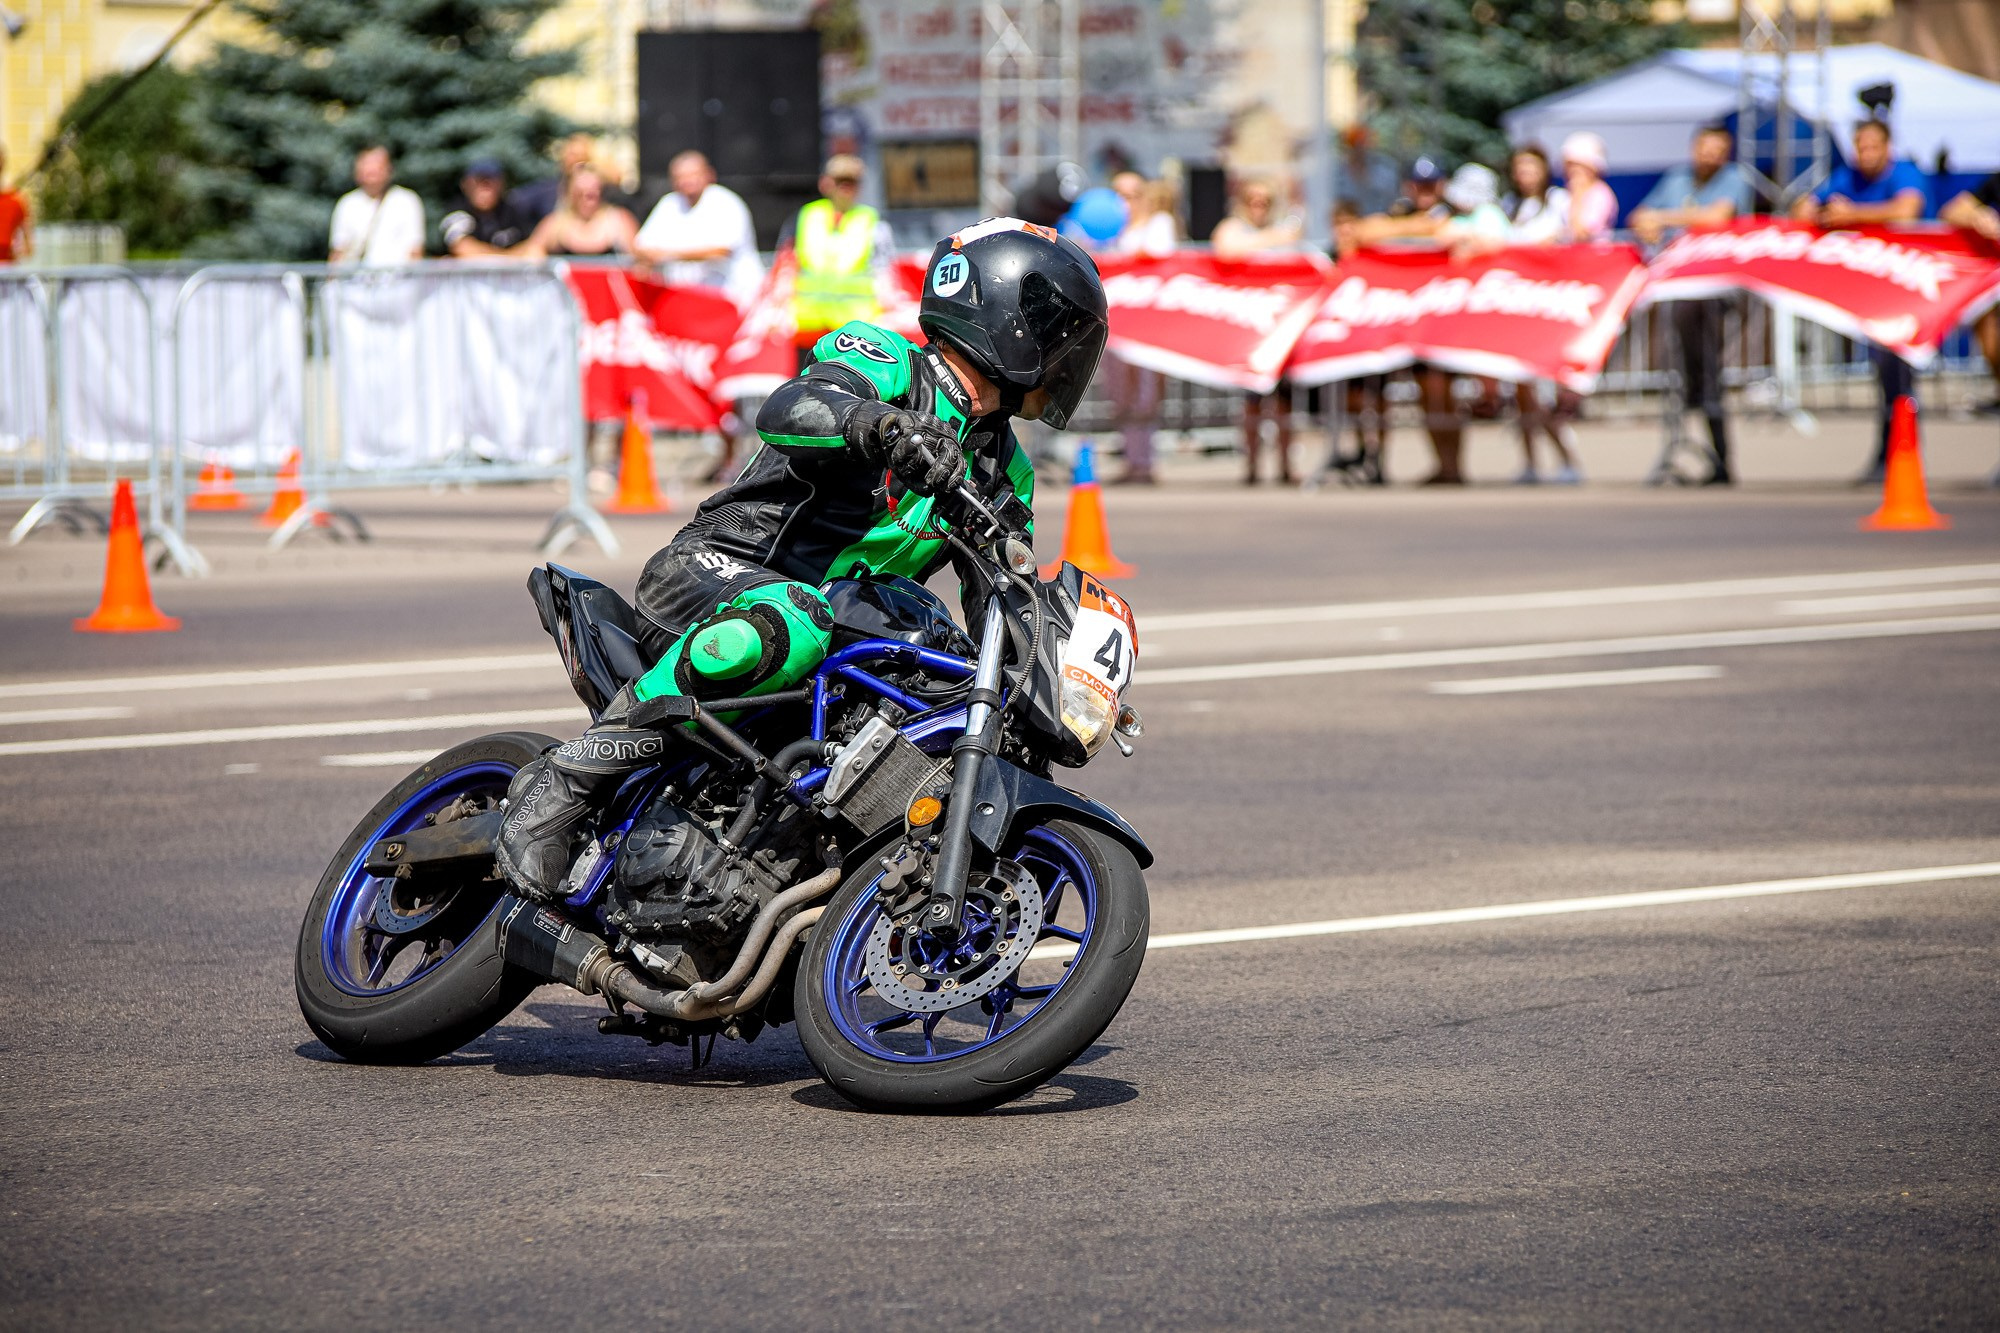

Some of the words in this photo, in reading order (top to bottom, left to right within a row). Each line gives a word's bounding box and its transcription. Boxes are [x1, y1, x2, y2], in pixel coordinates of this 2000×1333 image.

[939, 263, 961, 286] 30
[927, 354, 969, 407] BERIK
[556, 736, 664, 761] daytona
